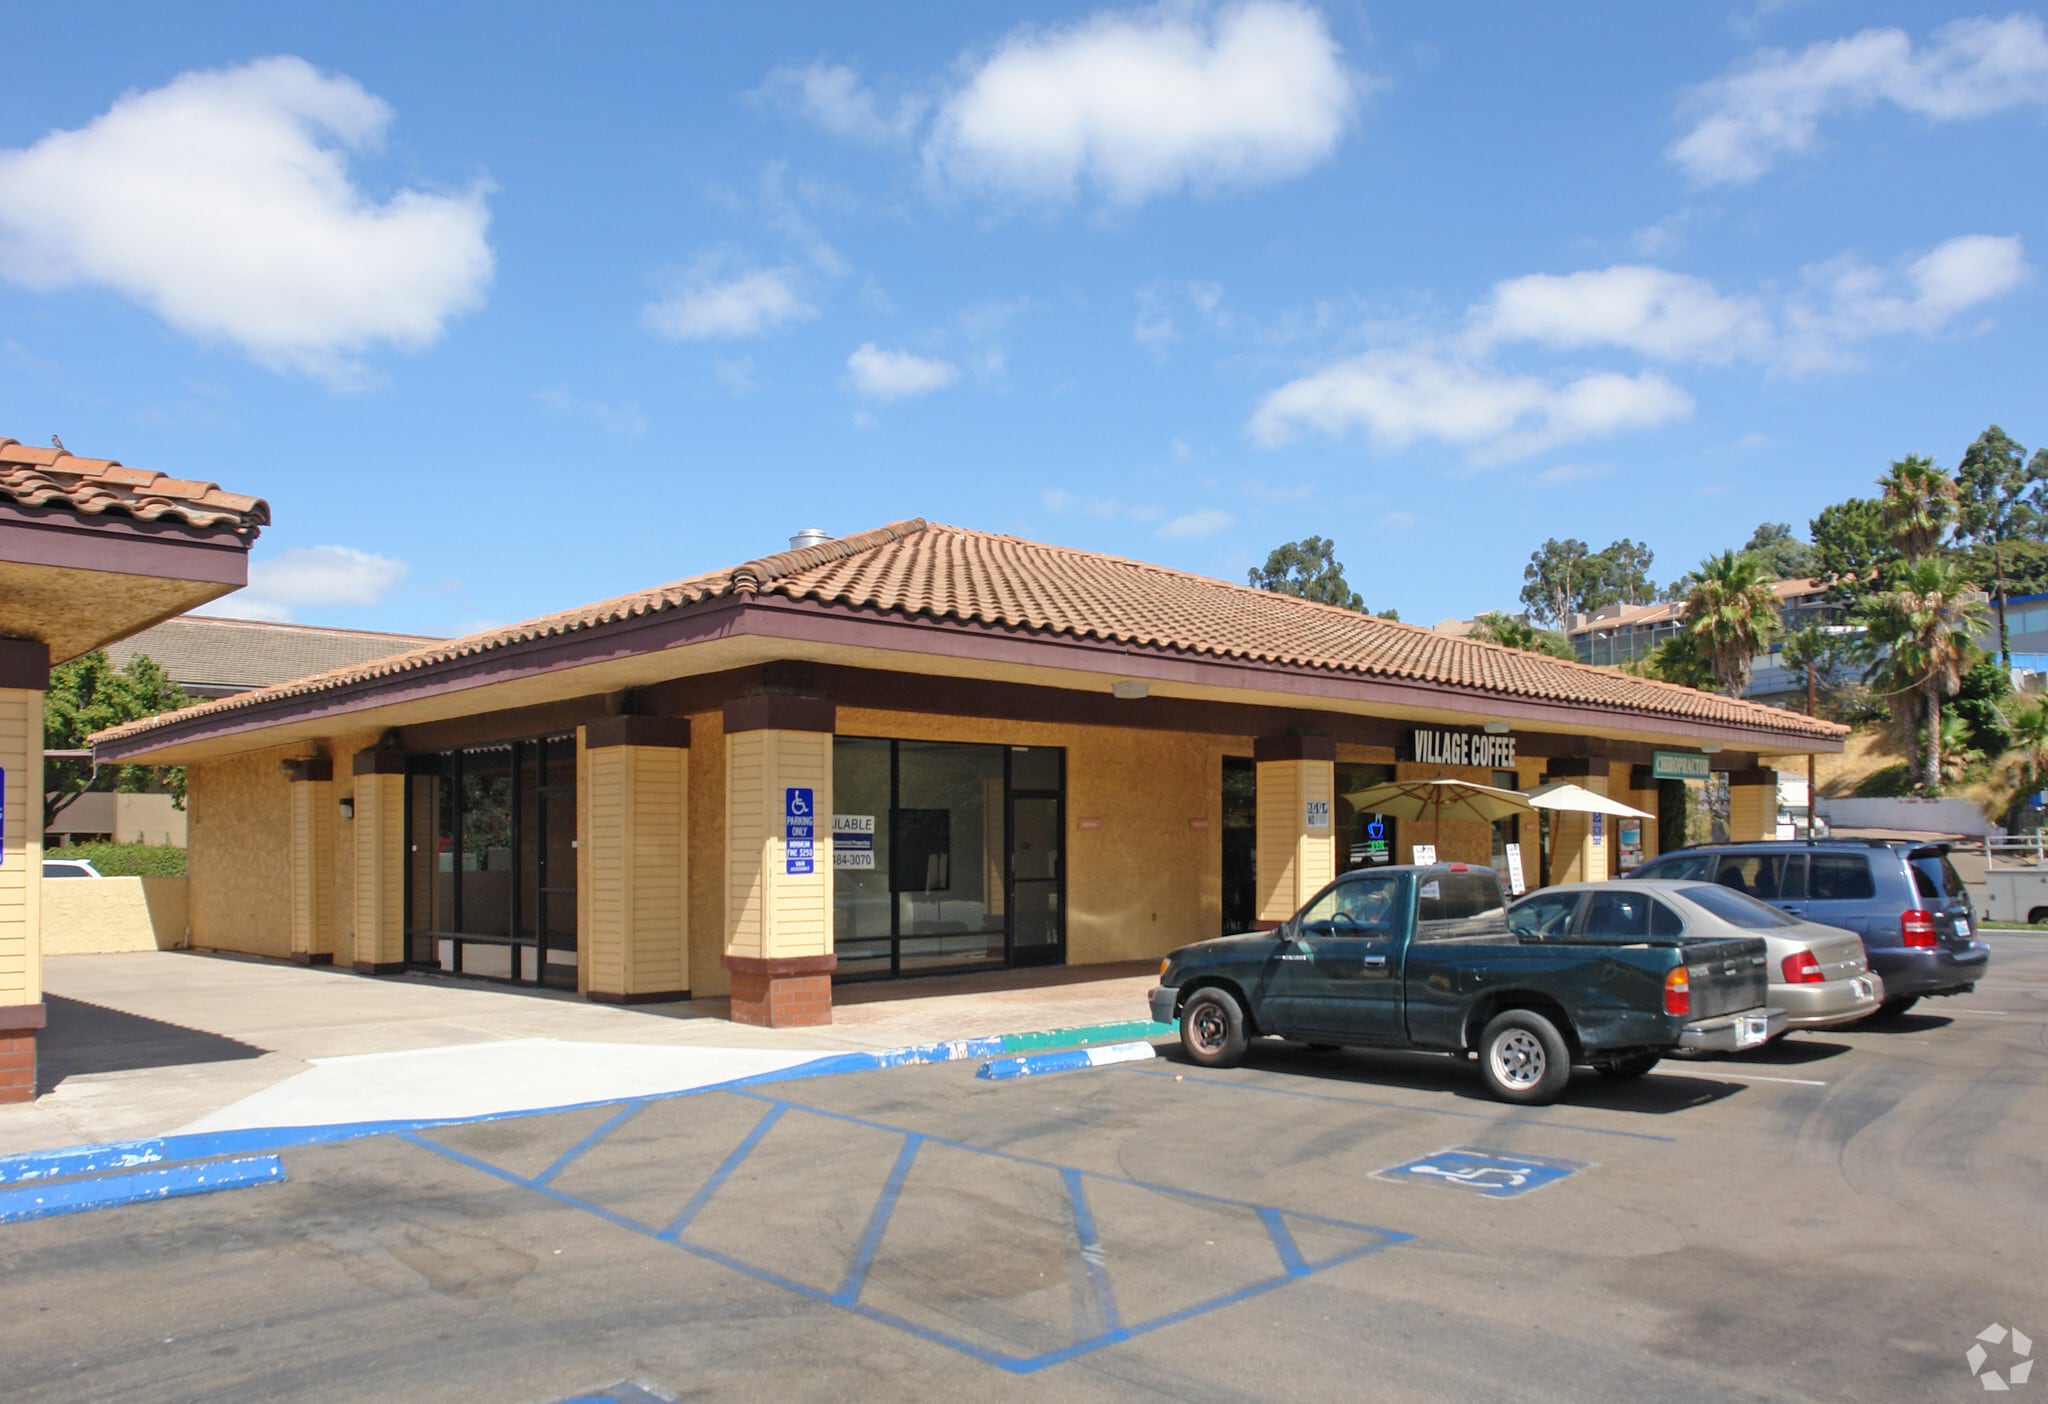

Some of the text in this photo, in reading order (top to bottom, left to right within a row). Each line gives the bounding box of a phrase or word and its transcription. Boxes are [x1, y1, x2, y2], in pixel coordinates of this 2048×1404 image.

[1415, 729, 1516, 768] VILLAGE COFFEE
[1656, 755, 1710, 775] CHIROPRACTOR
[786, 816, 813, 826] PARKING
[832, 818, 872, 830] ILABLE
[792, 827, 808, 837] ONLY
[789, 840, 811, 848] MINIMUM
[787, 849, 813, 857] FINE $250
